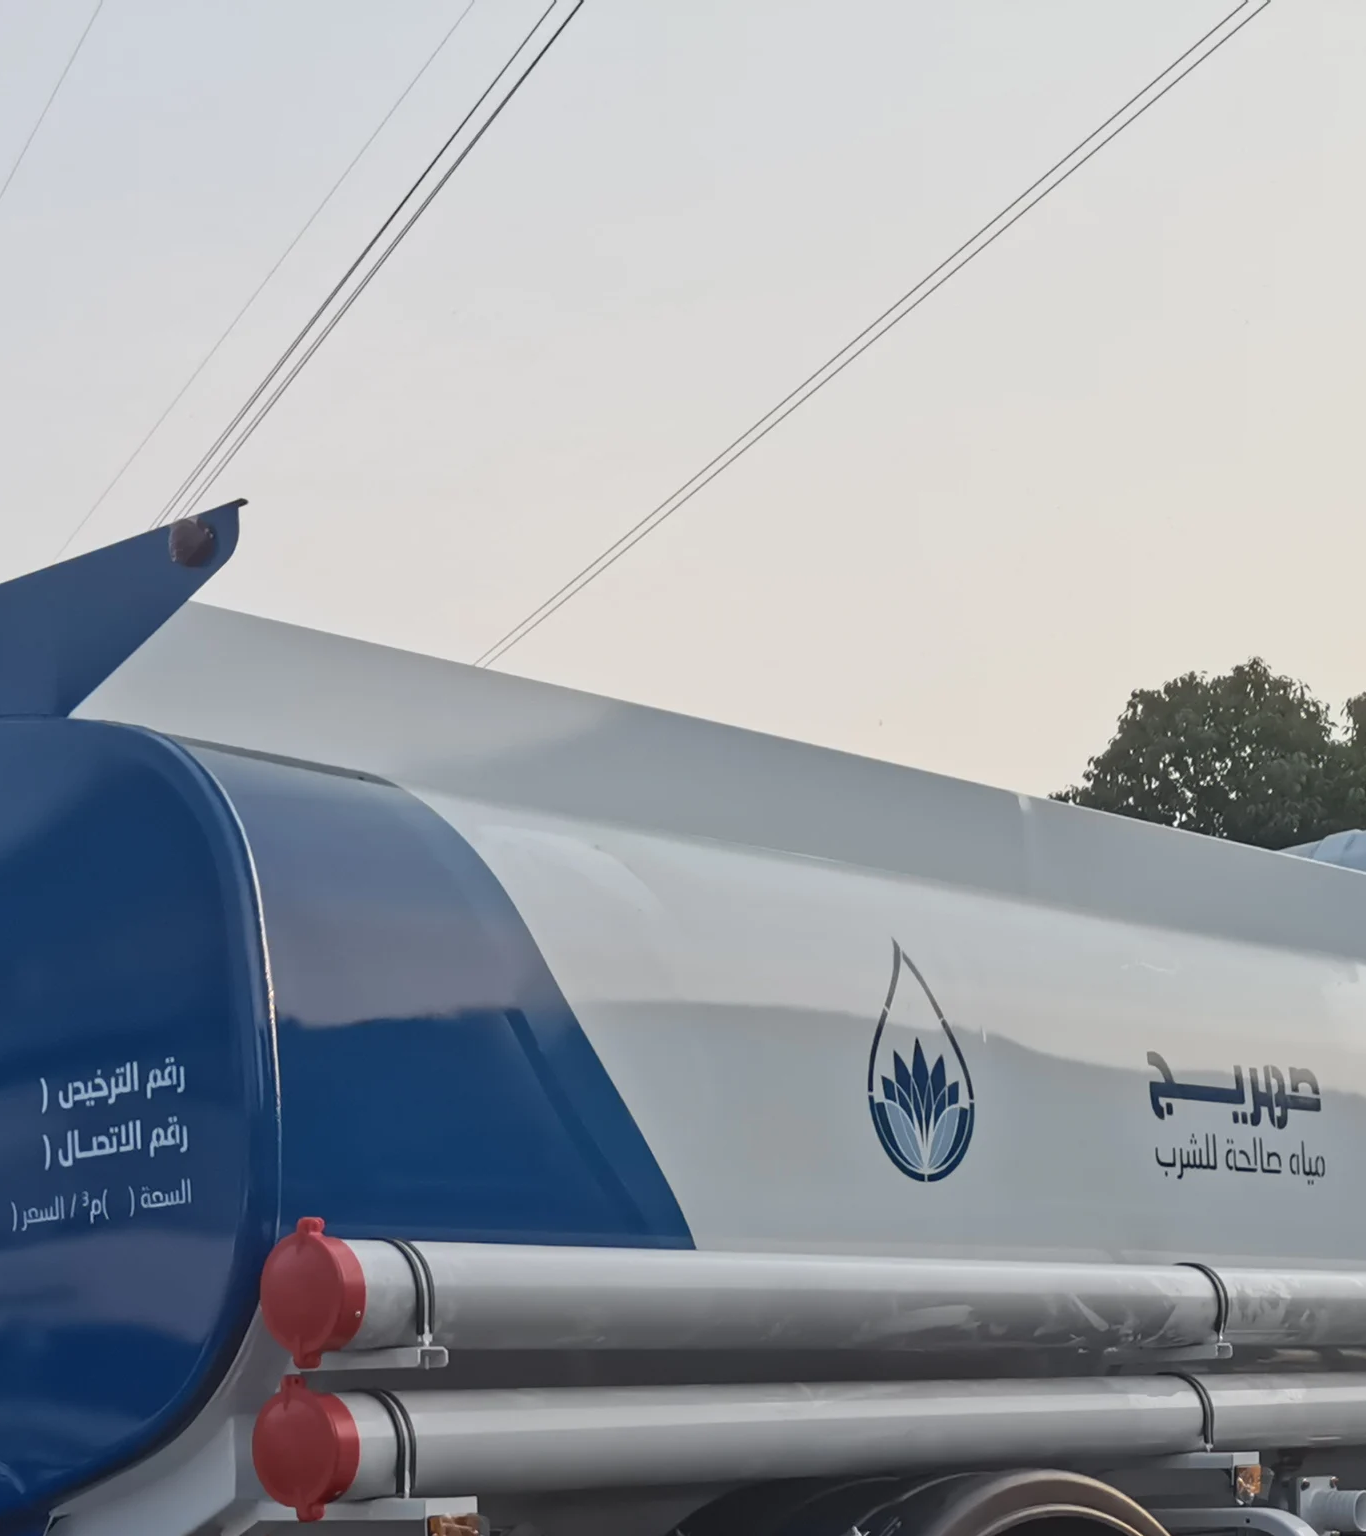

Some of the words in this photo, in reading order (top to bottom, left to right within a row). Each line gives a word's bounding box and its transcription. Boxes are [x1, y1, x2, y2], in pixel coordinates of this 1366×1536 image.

[57, 1060, 140, 1110] الترخيص
[145, 1056, 186, 1100] رقم
[57, 1119, 142, 1168] الاتصال
[149, 1115, 189, 1158] رقم
[1154, 1132, 1218, 1181] للشرب
[1224, 1136, 1283, 1175] صالحة
[1288, 1139, 1326, 1186] مياه
[20, 1195, 65, 1232] السعر
[140, 1177, 192, 1209] السعة
